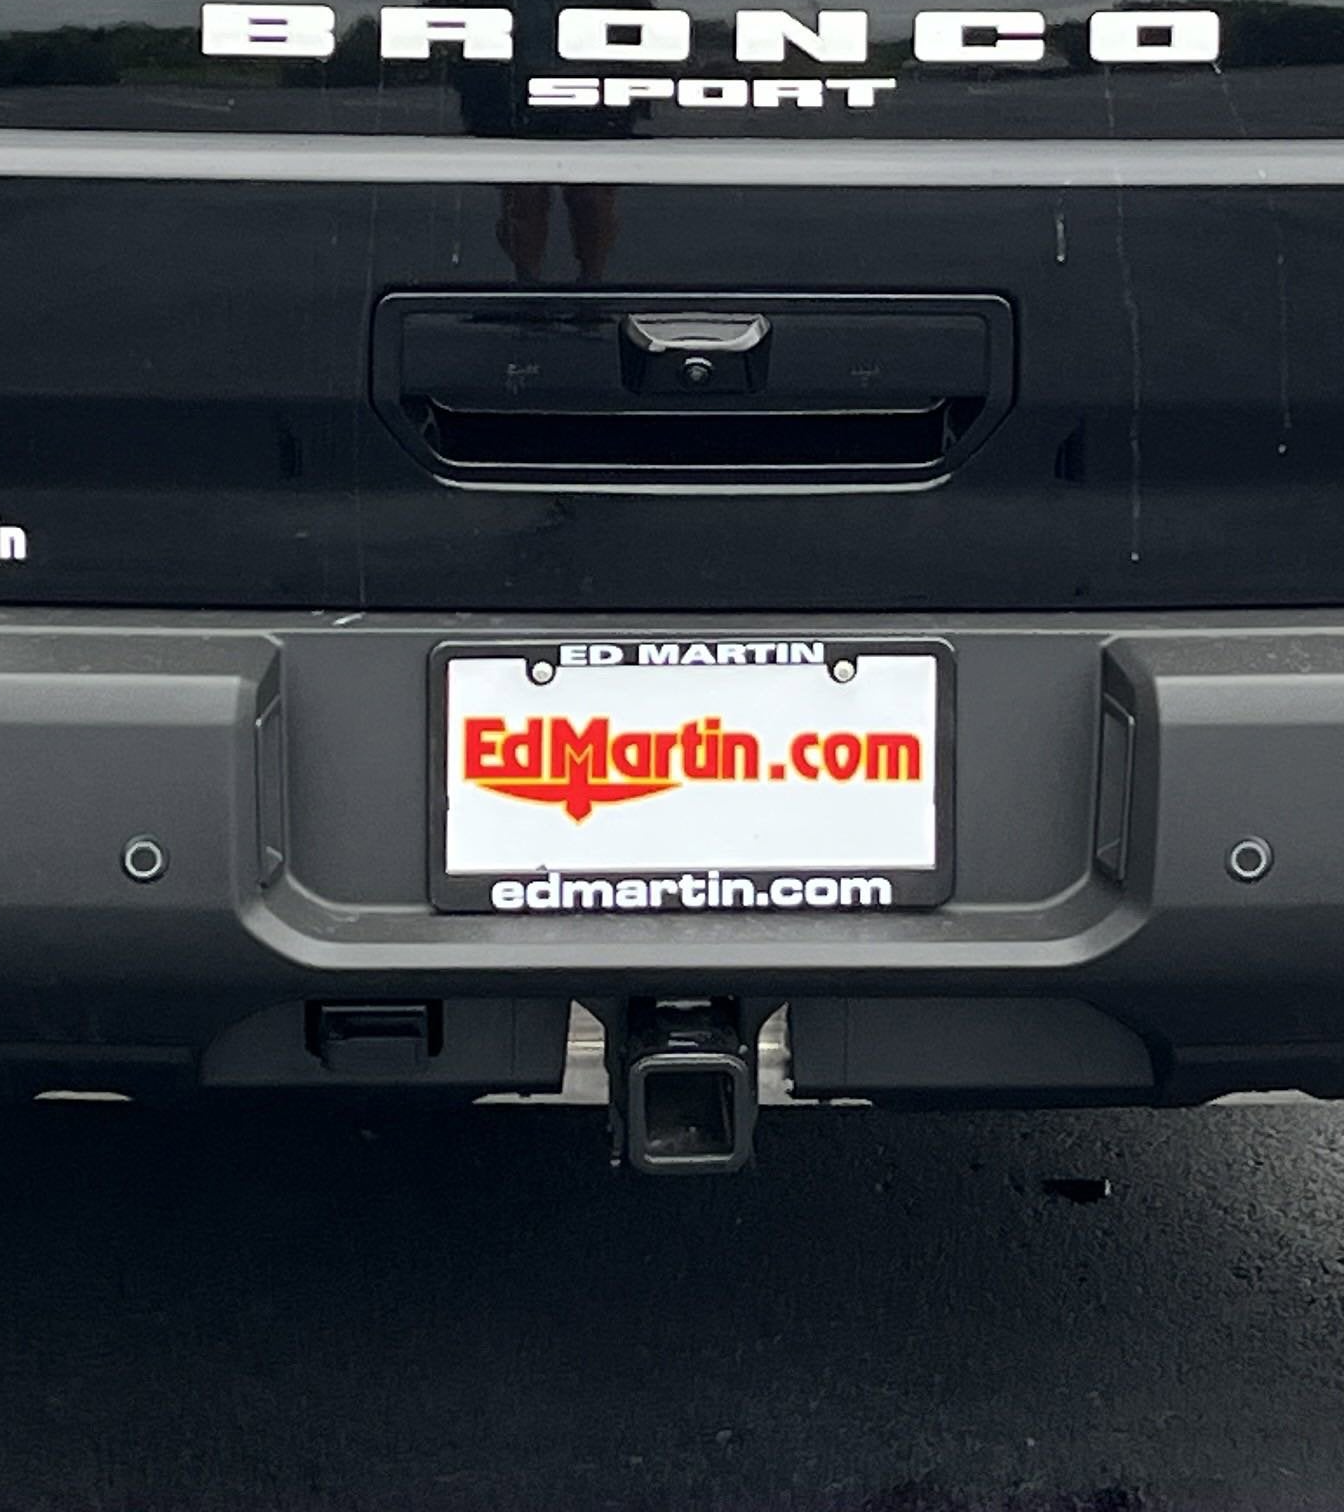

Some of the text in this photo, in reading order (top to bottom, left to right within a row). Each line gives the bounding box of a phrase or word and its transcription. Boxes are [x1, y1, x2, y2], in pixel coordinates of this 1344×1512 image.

[202, 4, 1220, 62] BRONCO
[528, 78, 896, 107] SPORT
[559, 641, 825, 666] ED MARTIN
[491, 870, 893, 910] edmartin.com
